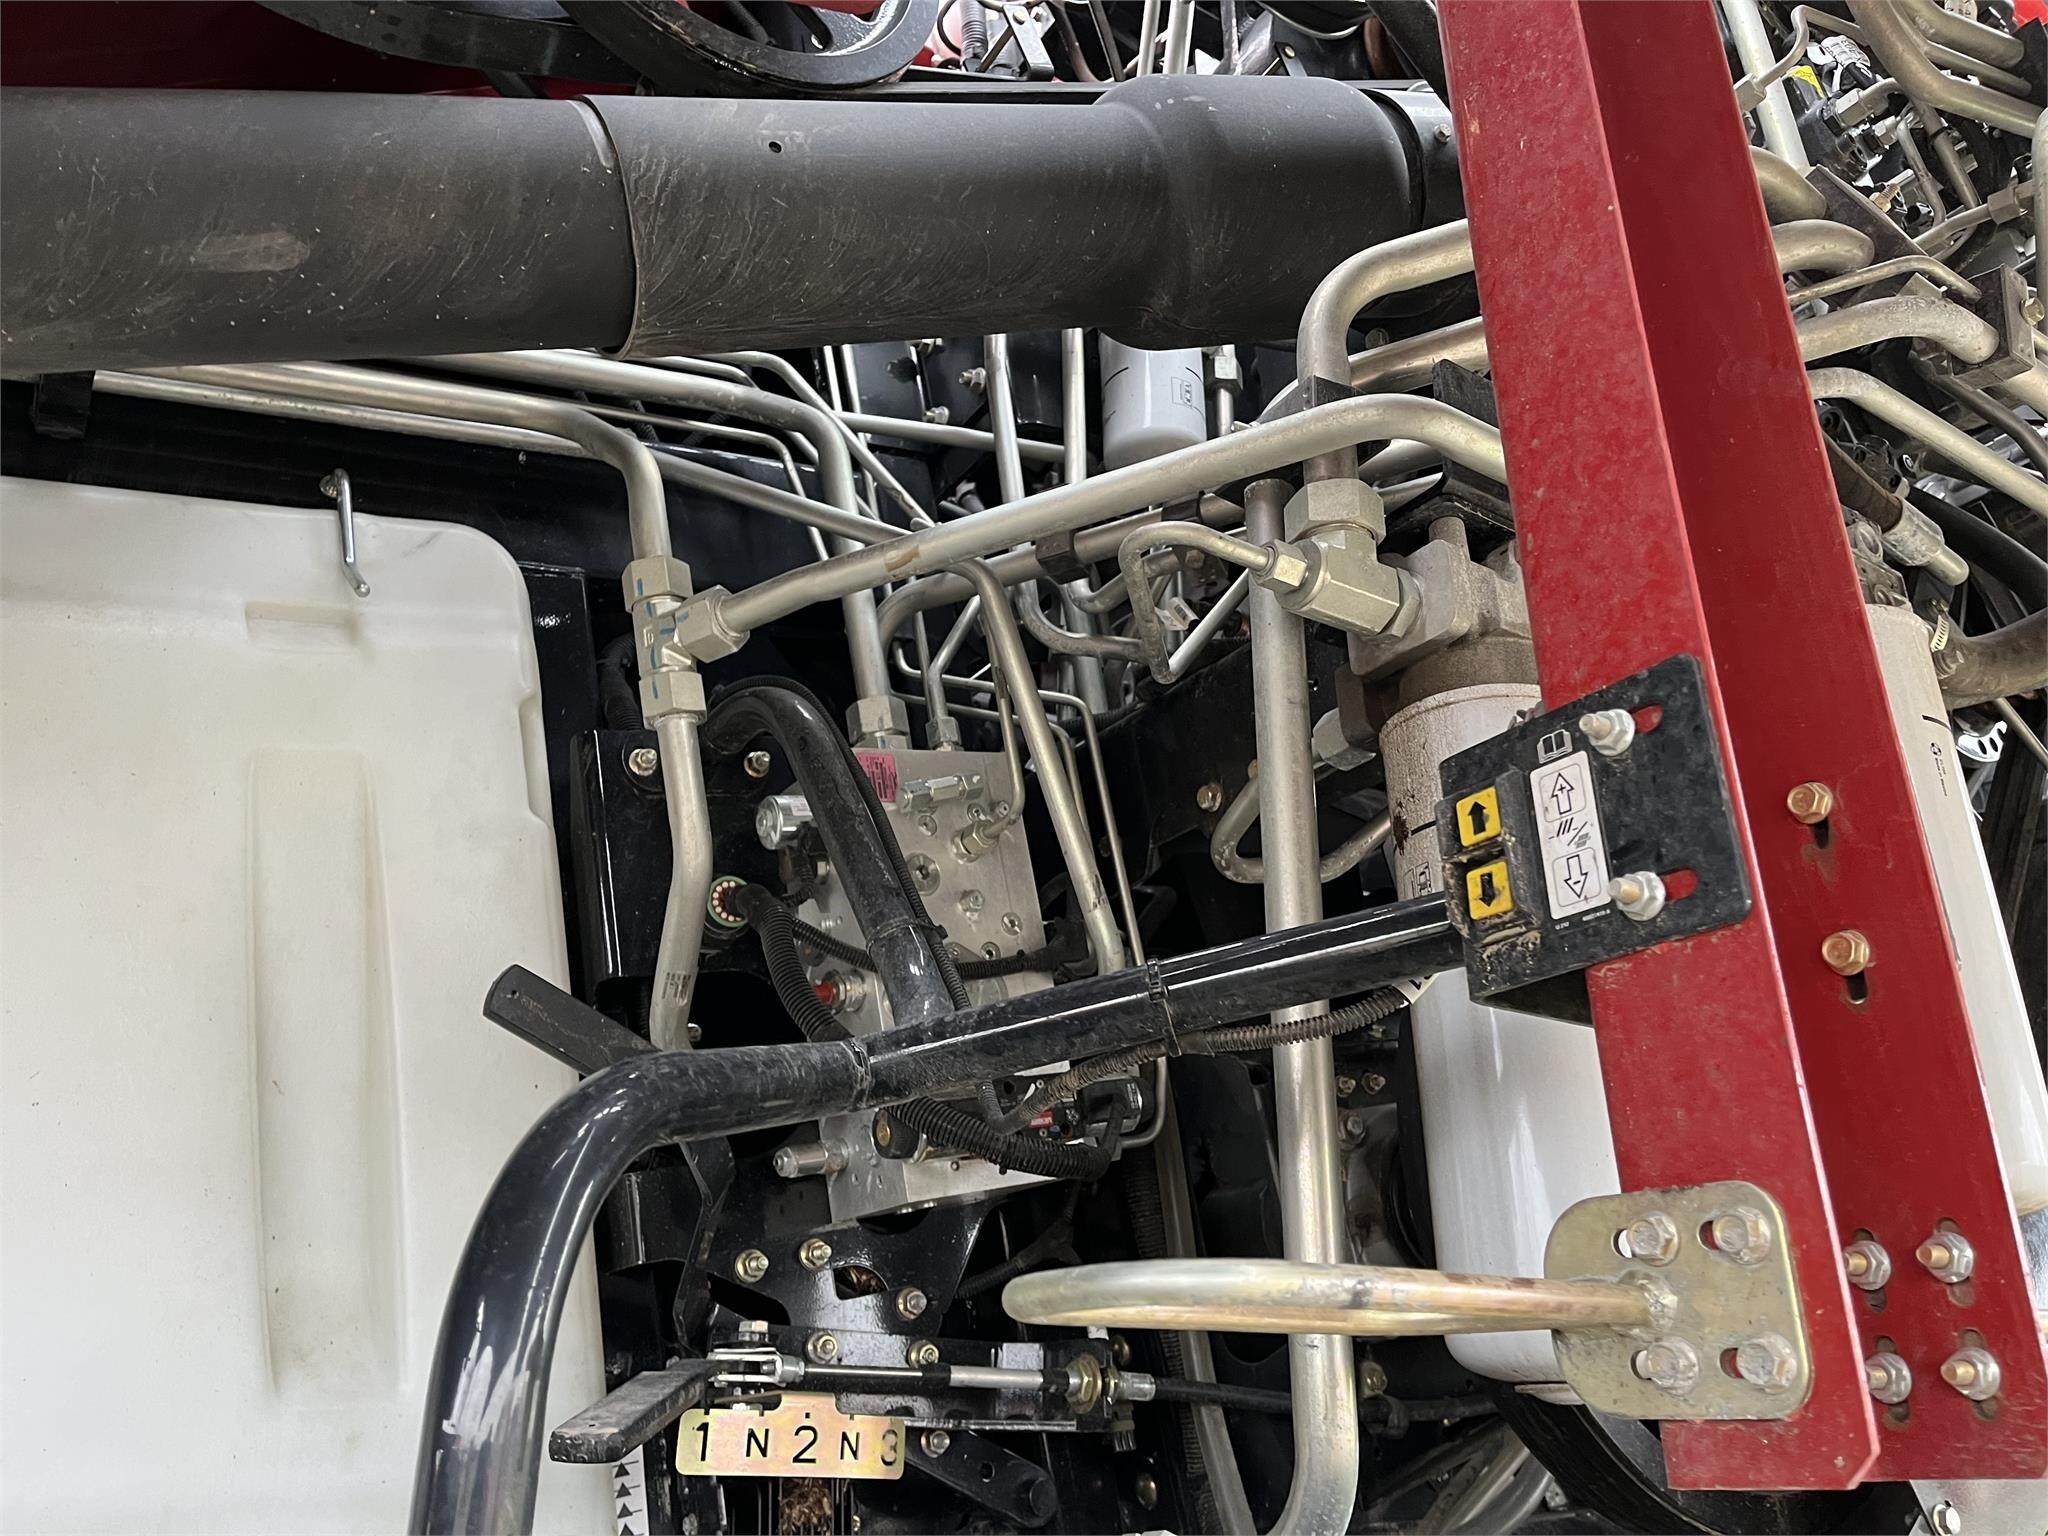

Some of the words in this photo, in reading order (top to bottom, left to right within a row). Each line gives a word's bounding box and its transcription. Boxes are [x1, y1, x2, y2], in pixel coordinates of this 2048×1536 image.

[695, 1421, 709, 1462] 1
[745, 1428, 770, 1458] N
[792, 1425, 818, 1464] 2
[840, 1431, 860, 1461] N
[880, 1429, 899, 1466] 3
